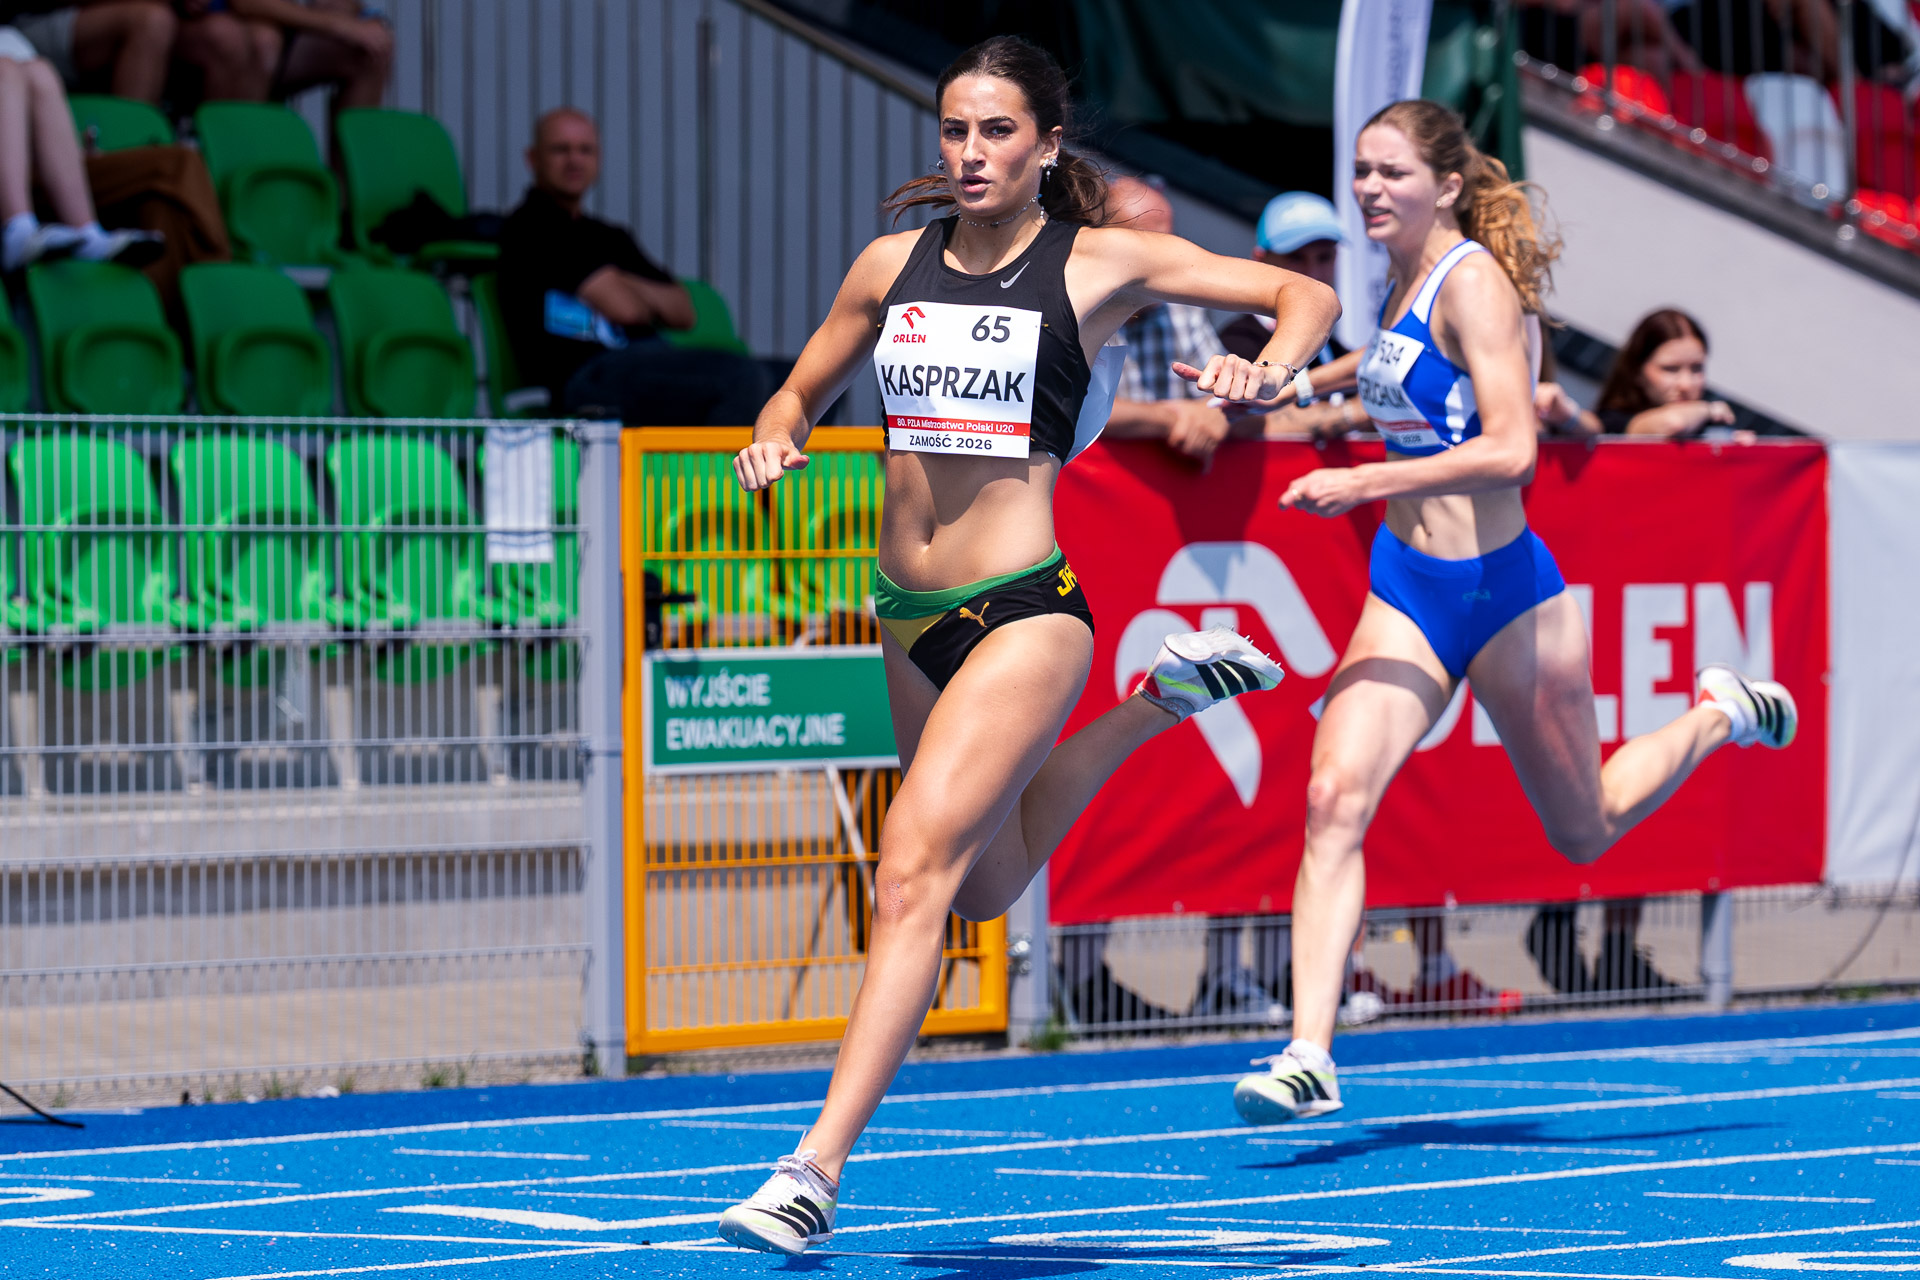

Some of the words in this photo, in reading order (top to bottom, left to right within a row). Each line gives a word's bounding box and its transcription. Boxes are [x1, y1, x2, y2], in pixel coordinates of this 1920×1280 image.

[893, 334, 927, 343] ORLEN
[971, 315, 1012, 343] 65
[880, 364, 1026, 403] KASPRZAK
[897, 418, 907, 427] 80.
[907, 419, 921, 427] PZLA
[921, 419, 964, 430] Mistrzostwa
[966, 422, 993, 432] Polski
[996, 424, 1014, 433] U20
[909, 434, 952, 448] ZAMOŚĆ
[956, 437, 992, 450] 2026
[1057, 560, 1077, 597] JA
[664, 667, 771, 708] WYJŚCIE
[666, 713, 846, 750] EWAKUACYJNE
